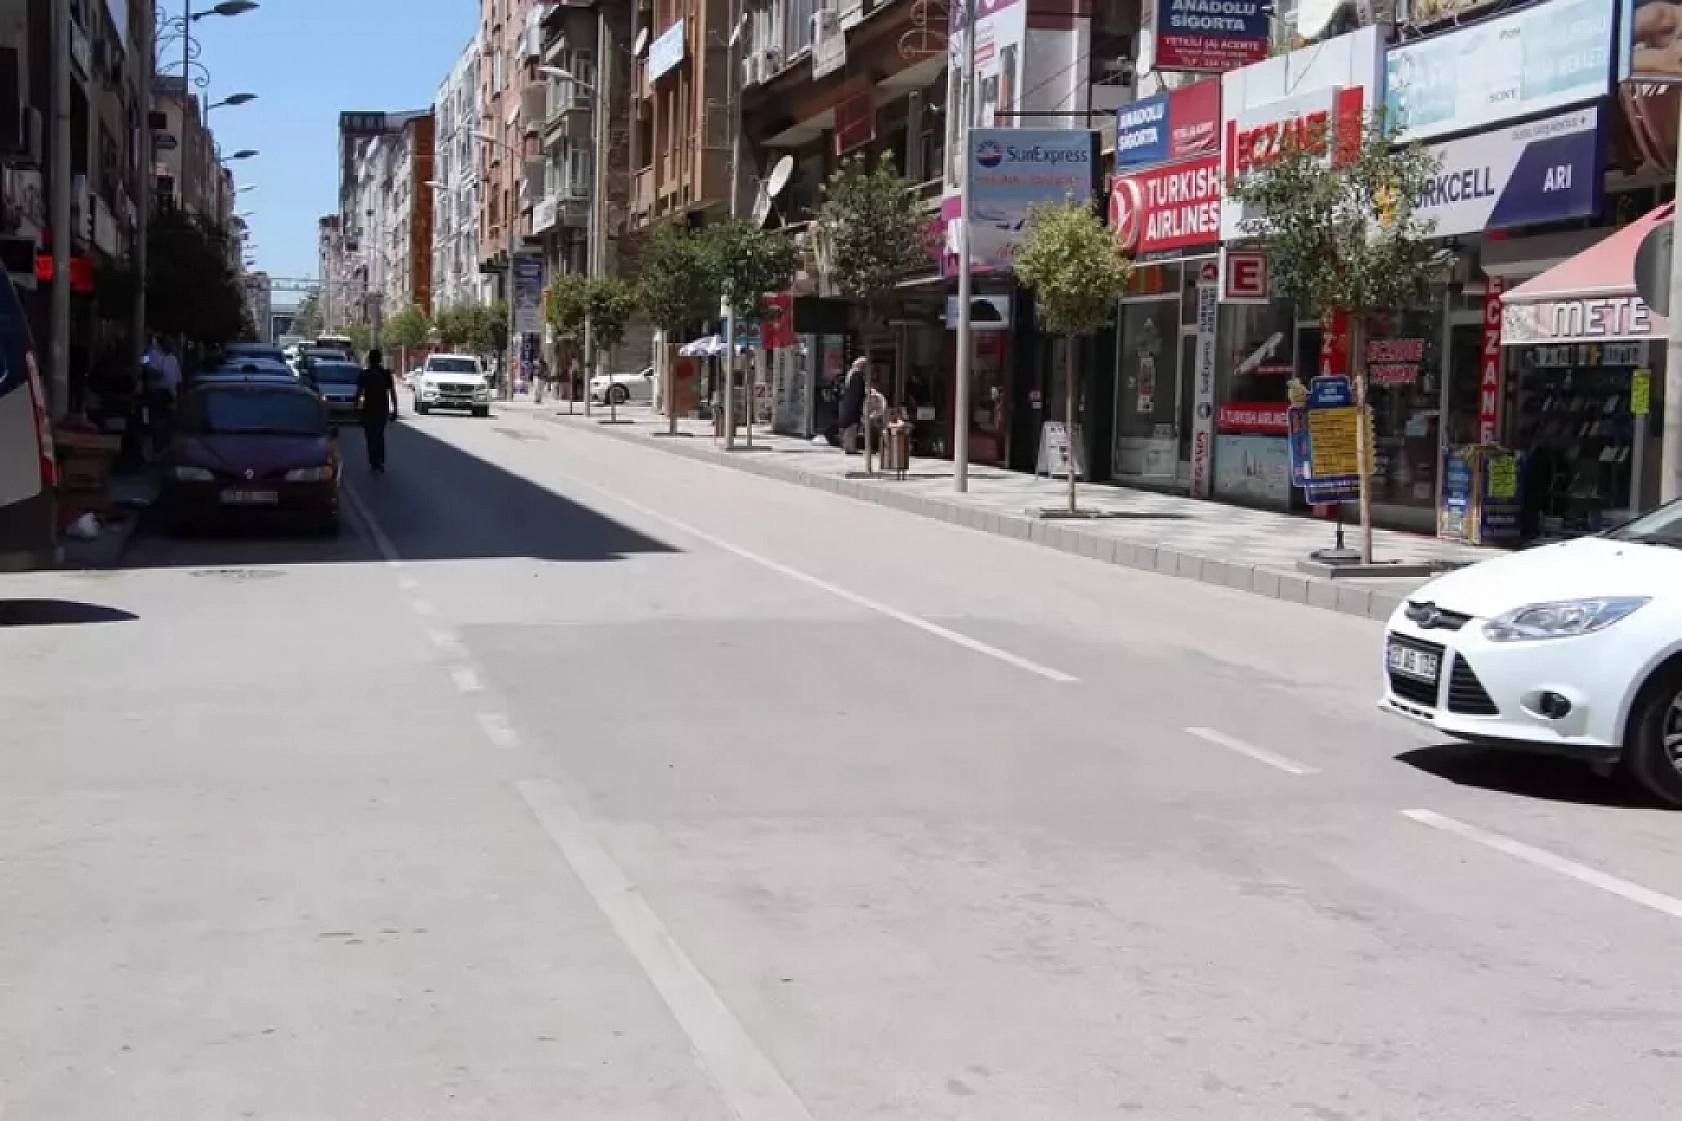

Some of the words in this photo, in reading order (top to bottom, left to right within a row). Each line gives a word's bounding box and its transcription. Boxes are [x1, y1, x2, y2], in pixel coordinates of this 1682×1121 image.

[1170, 13, 1246, 31] SİGORTA
[1171, 0, 1257, 15] ANADOLU
[1006, 146, 1088, 167] SunExpress
[1147, 164, 1221, 208] TURKISH
[1543, 163, 1572, 193] ARI
[1145, 200, 1221, 241] AIRLINES
[1234, 259, 1260, 292] E
[1551, 296, 1651, 338] METE
